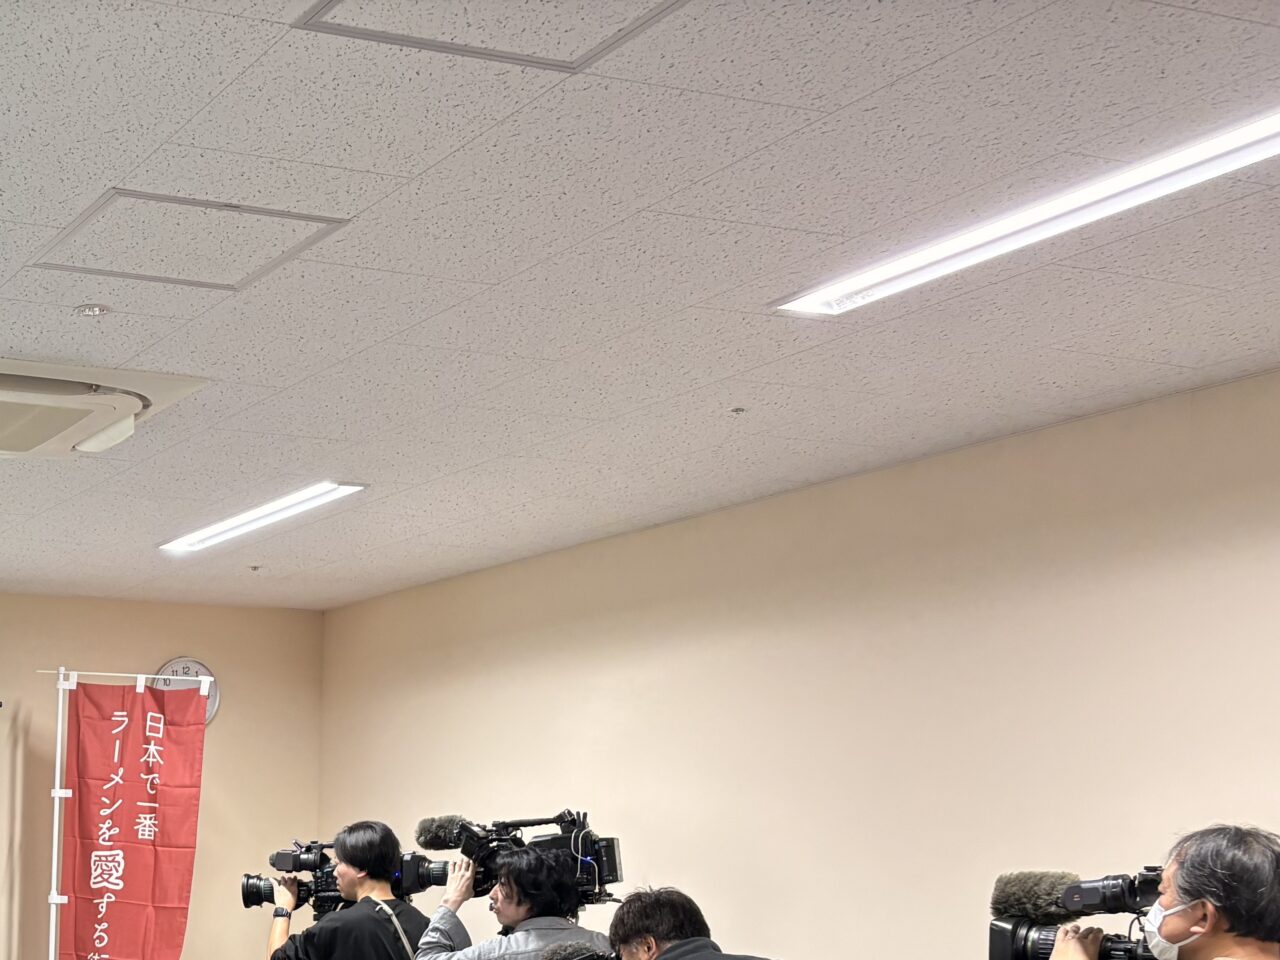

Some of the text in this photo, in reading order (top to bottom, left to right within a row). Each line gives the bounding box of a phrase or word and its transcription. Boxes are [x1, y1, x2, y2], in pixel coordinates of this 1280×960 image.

[182, 666, 190, 675] 12
[163, 678, 170, 686] 10
[133, 711, 165, 841] 日本で一番
